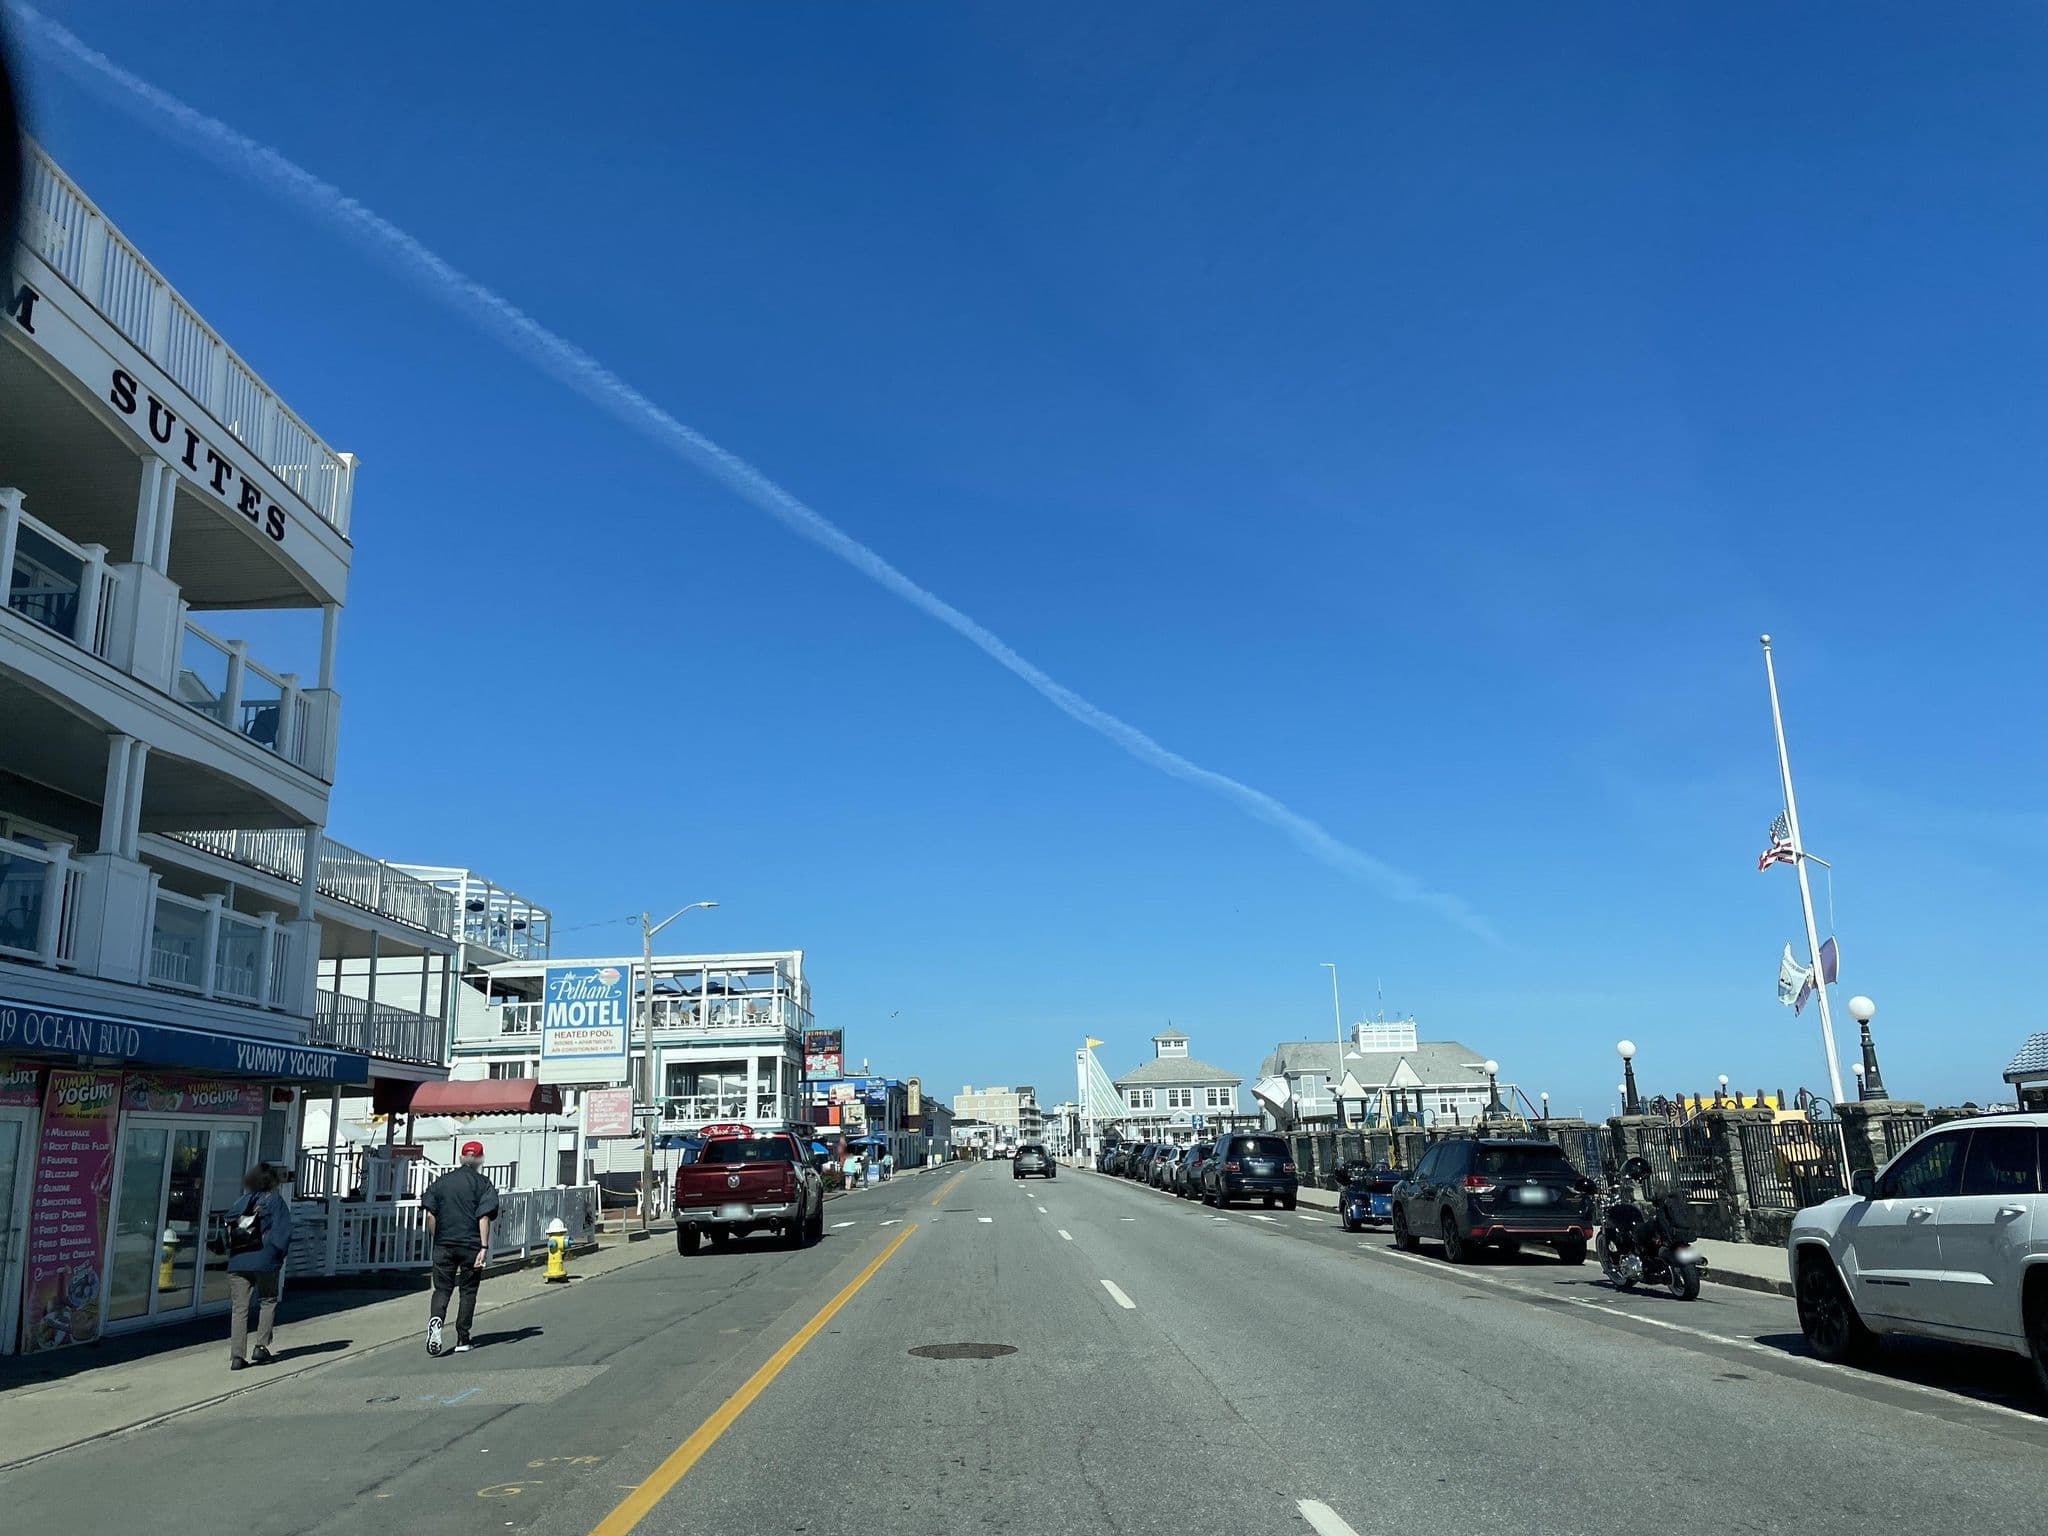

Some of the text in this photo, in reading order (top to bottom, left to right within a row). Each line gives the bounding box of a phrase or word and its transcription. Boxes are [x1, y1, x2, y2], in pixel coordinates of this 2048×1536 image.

[110, 369, 286, 541] SUITES
[550, 979, 622, 1001] Pelham
[546, 1000, 623, 1027] MOTEL
[24, 1013, 93, 1051] OCEAN
[98, 1023, 140, 1057] BLVD
[554, 1029, 614, 1039] HEATED POOL
[237, 1043, 337, 1079] YUMMY YOGURT
[54, 1075, 98, 1090] YUMMY
[187, 1081, 224, 1095] YUMMY
[57, 1083, 115, 1105] YOGURT
[192, 1089, 240, 1106] YOGURT
[50, 1128, 90, 1137] MILKSHAKE
[49, 1142, 69, 1151] ROOT
[71, 1142, 90, 1151] BEER
[41, 1198, 82, 1207] SMOOTHIES
[40, 1210, 87, 1221] FRIED DOUGH
[39, 1226, 58, 1235] FRIED
[39, 1237, 91, 1249] FRIED BANANAS
[38, 1254, 57, 1263] FRIED
